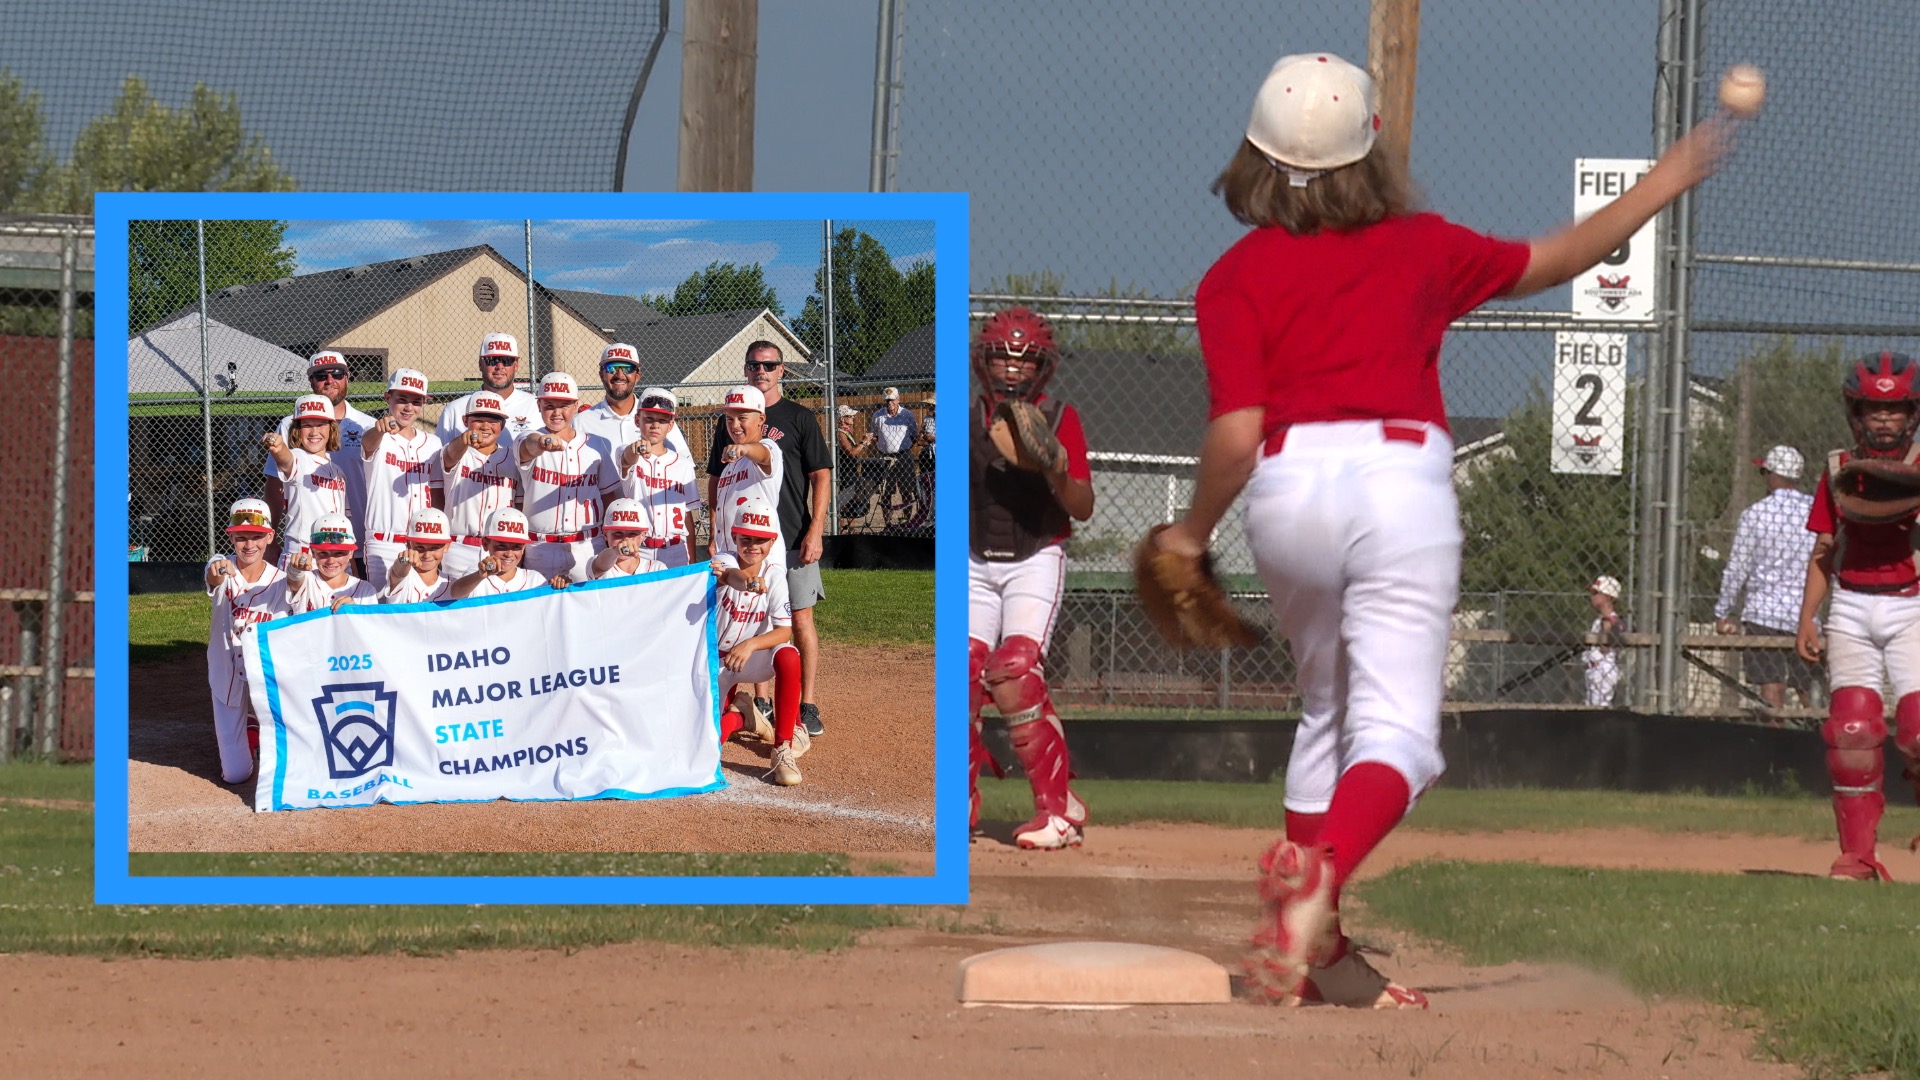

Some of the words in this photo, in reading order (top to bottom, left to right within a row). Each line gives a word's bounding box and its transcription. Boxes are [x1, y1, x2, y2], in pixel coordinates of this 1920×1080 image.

[1580, 172, 1648, 196] FIEL
[487, 341, 512, 352] SWA
[607, 348, 632, 359] SWA
[314, 355, 338, 366] SWA
[1559, 343, 1622, 366] FIELD
[401, 376, 425, 391] SWA
[543, 382, 570, 394] SWA
[299, 401, 326, 412] SWA
[475, 398, 501, 410] SWA
[1574, 373, 1604, 426] 2
[768, 427, 785, 441] OF
[612, 510, 640, 523] SWA
[672, 507, 684, 530] 2
[742, 512, 770, 527] SWA
[415, 521, 443, 534] SWA
[497, 520, 525, 534] SWA
[327, 653, 373, 672] 2025
[427, 646, 511, 673] IDAHO
[431, 680, 523, 708] MAJOR
[529, 664, 621, 696] LEAGUE
[435, 718, 504, 744] STATE
[438, 736, 589, 776] CHAMPIONS
[307, 773, 414, 800] BASEBALL
